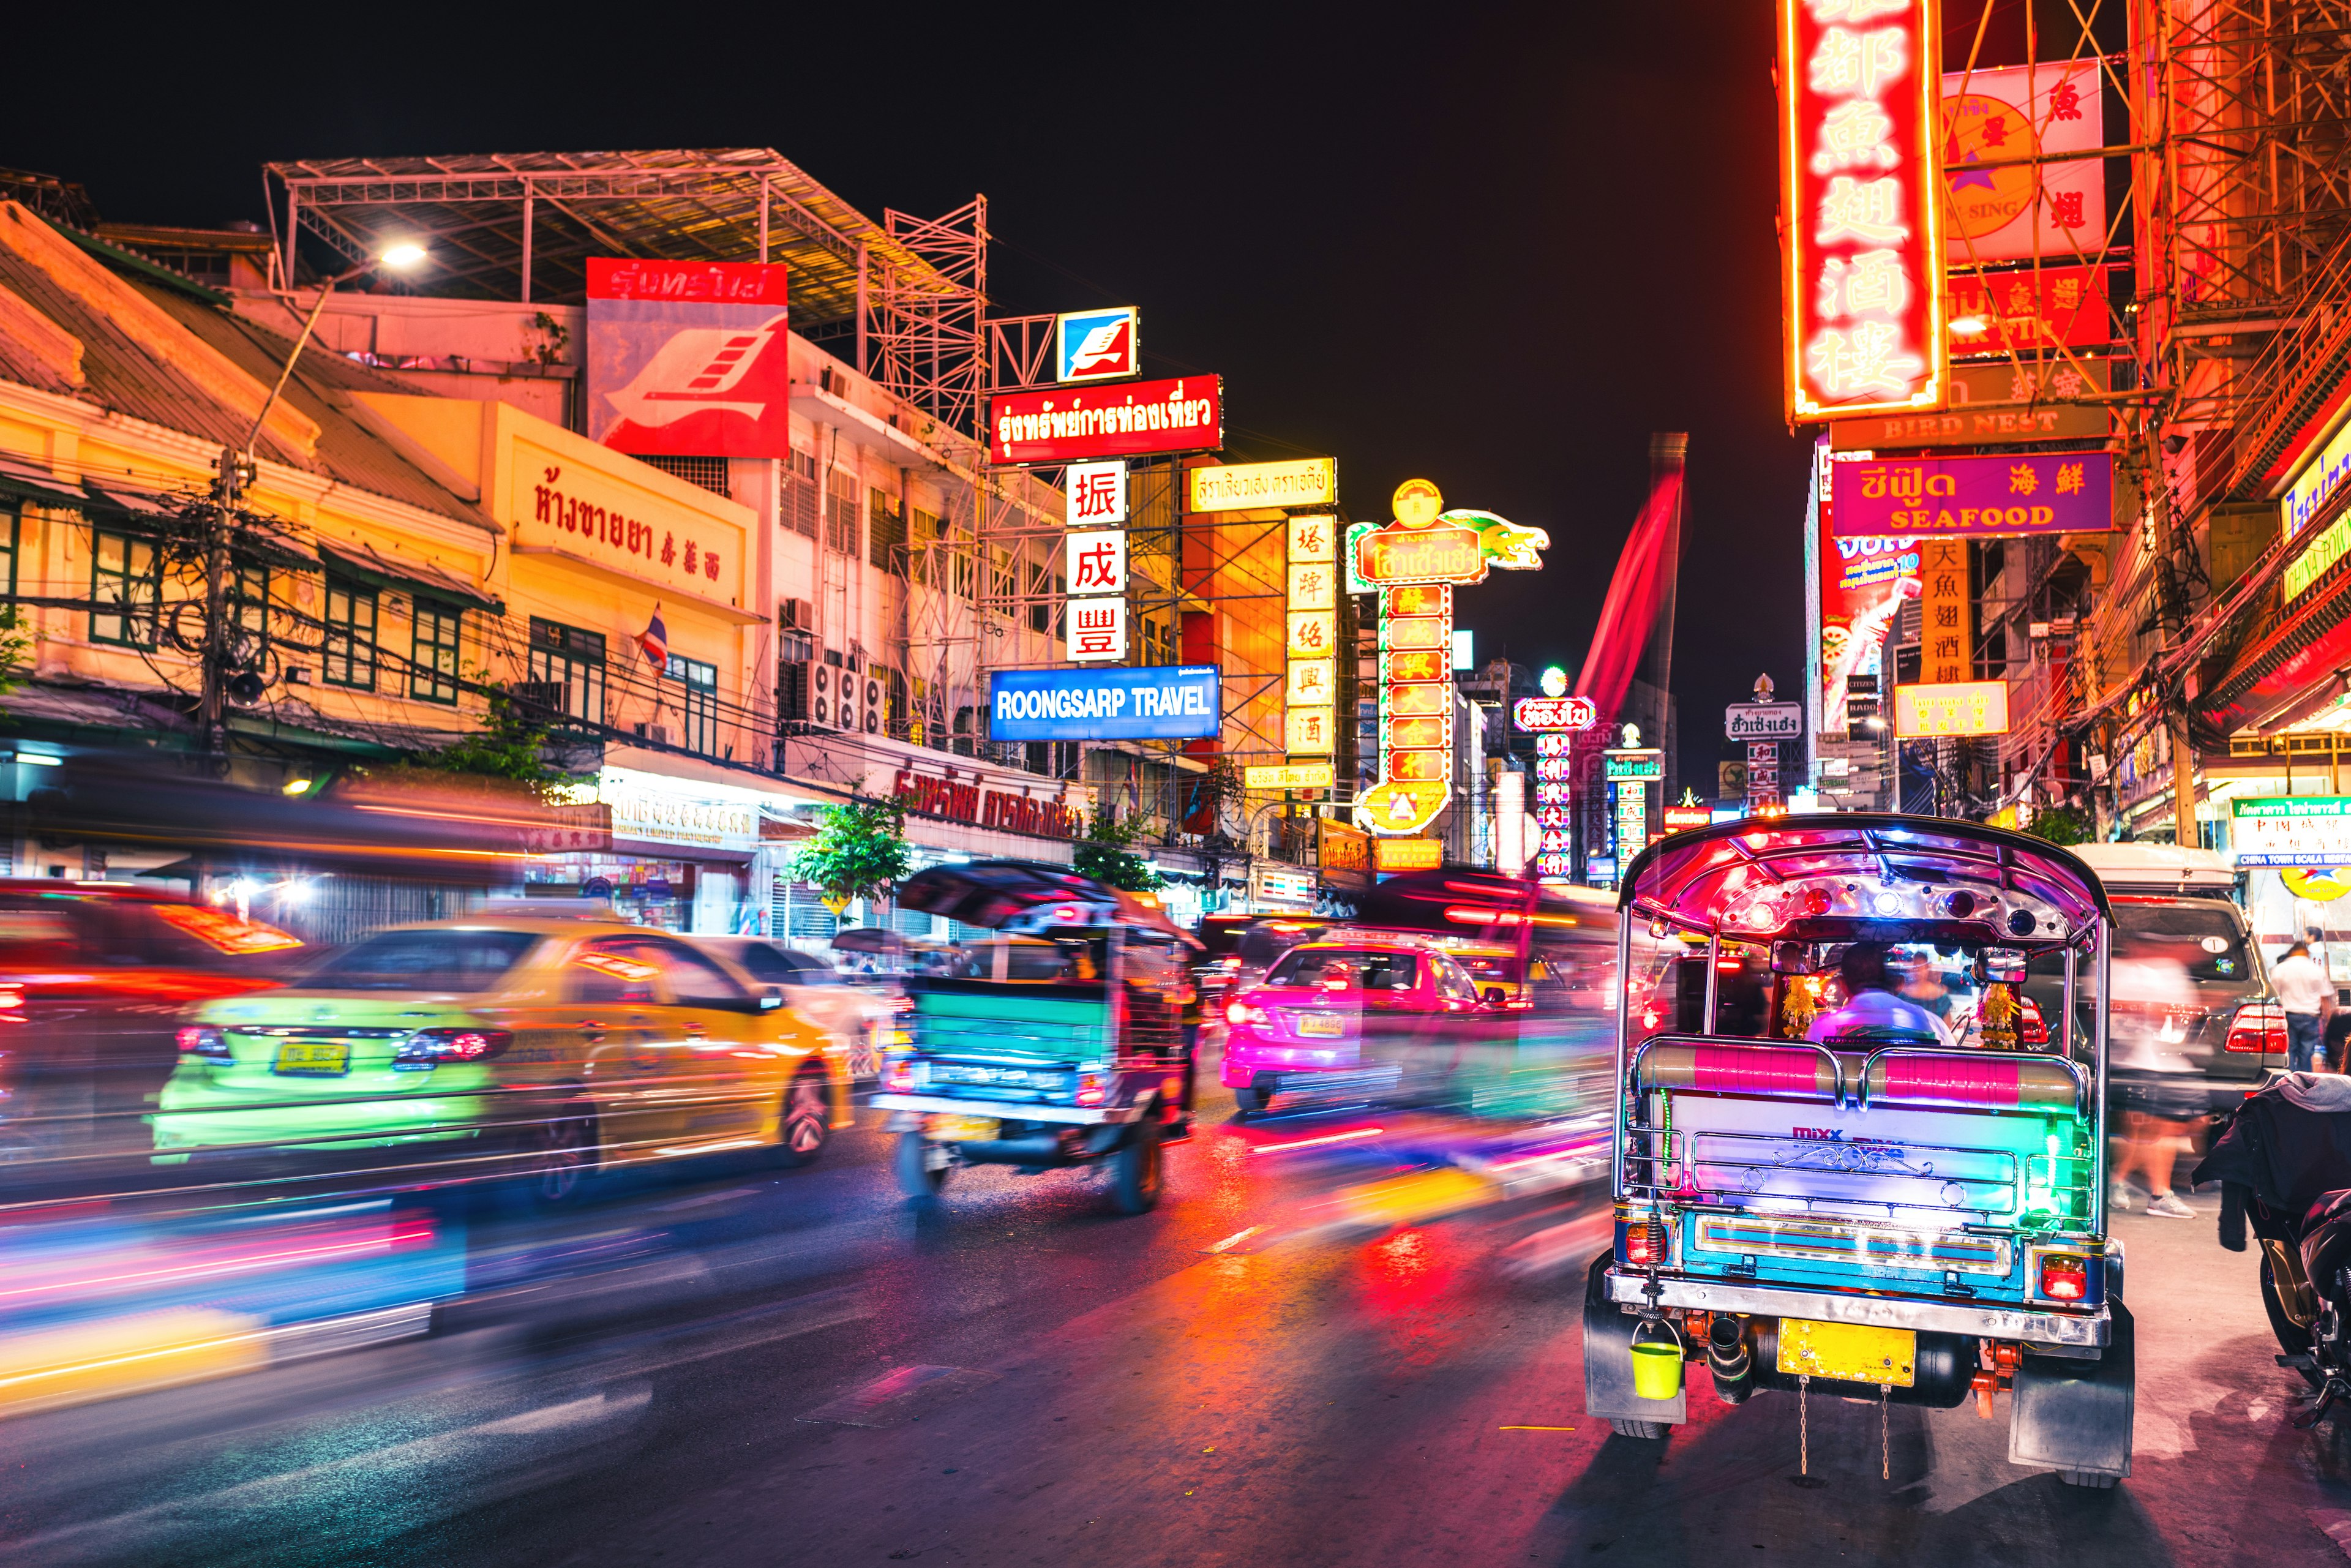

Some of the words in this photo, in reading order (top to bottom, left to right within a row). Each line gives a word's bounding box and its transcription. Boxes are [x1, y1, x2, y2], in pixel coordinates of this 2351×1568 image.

[1968, 201, 2019, 219] SING
[999, 380, 1211, 457] รุ่งทรัพย์การท่องเที่ยว
[1884, 416, 1963, 439] BIRD
[1973, 411, 2058, 435] NEST
[2009, 462, 2085, 497] 海鮮
[534, 467, 652, 560] ห้างขายยา
[1890, 506, 2055, 529] SEAFOOD
[1075, 472, 1117, 653] 振成豐
[1897, 552, 1919, 570] 10
[2288, 552, 2319, 599] CHINA
[997, 688, 1126, 719] ROONGSARP
[1131, 685, 1210, 717] TRAVEL
[2240, 855, 2267, 865] CHINA
[2268, 855, 2295, 864] TOWN
[2209, 939, 2219, 950] T
